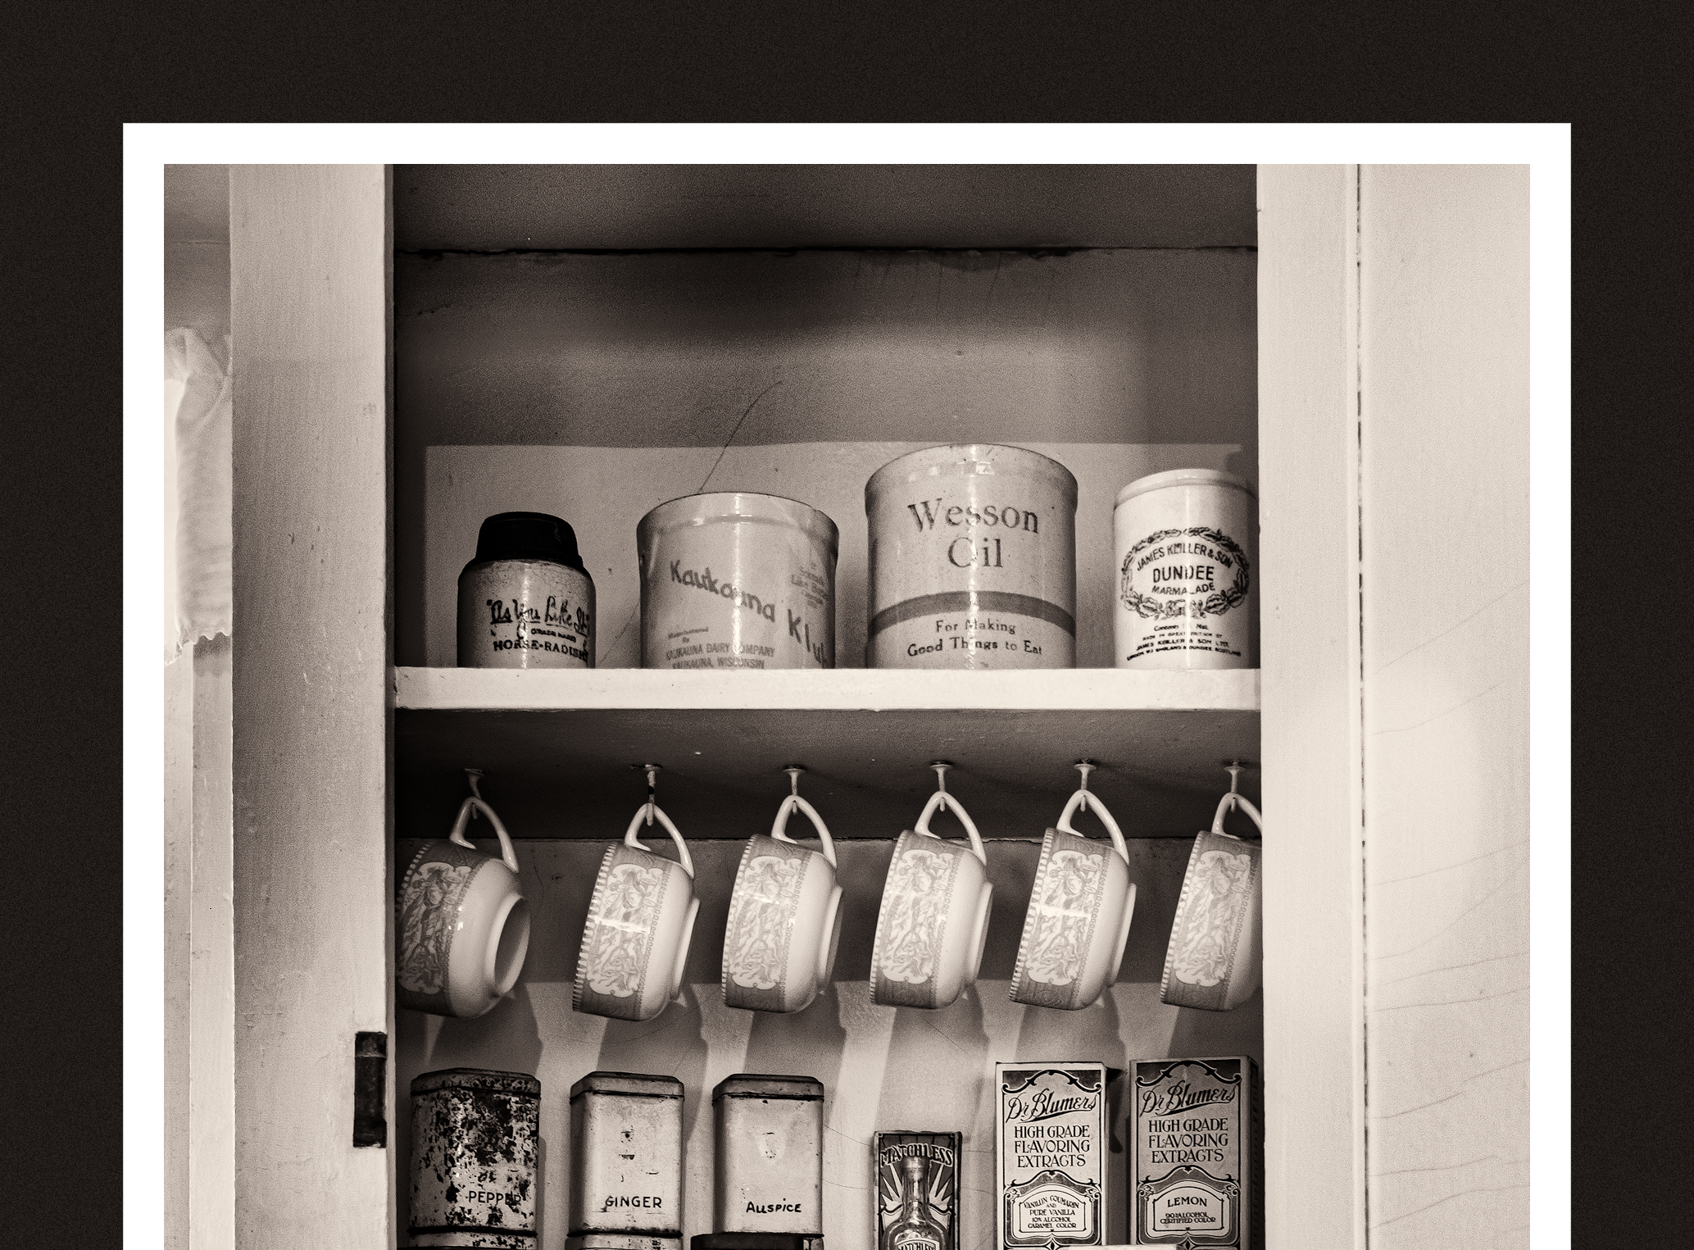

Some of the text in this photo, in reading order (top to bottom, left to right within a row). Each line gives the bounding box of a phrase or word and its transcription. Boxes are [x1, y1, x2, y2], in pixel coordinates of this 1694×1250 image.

[908, 498, 1039, 534] Wesson
[948, 537, 1004, 568] Oil
[1136, 547, 1165, 571] JAMES
[1207, 548, 1214, 558] &
[1153, 565, 1215, 583] DUNDEE
[1151, 581, 1216, 595] MARMALADE
[936, 619, 1016, 635] For Making
[907, 637, 1043, 657] Good Things to Eat
[1014, 1125, 1090, 1139] HIGH GRADE
[1149, 1118, 1229, 1133] HIGH GRADE
[1014, 1139, 1091, 1154] FLAVORING
[1149, 1133, 1229, 1149] FLAVORING
[881, 1143, 952, 1166] MATCHLESS
[1017, 1154, 1086, 1168] EXTRACTS
[1151, 1149, 1224, 1164] EXTRACTS
[605, 1196, 662, 1209] GINGER
[1167, 1196, 1208, 1208] LEMON
